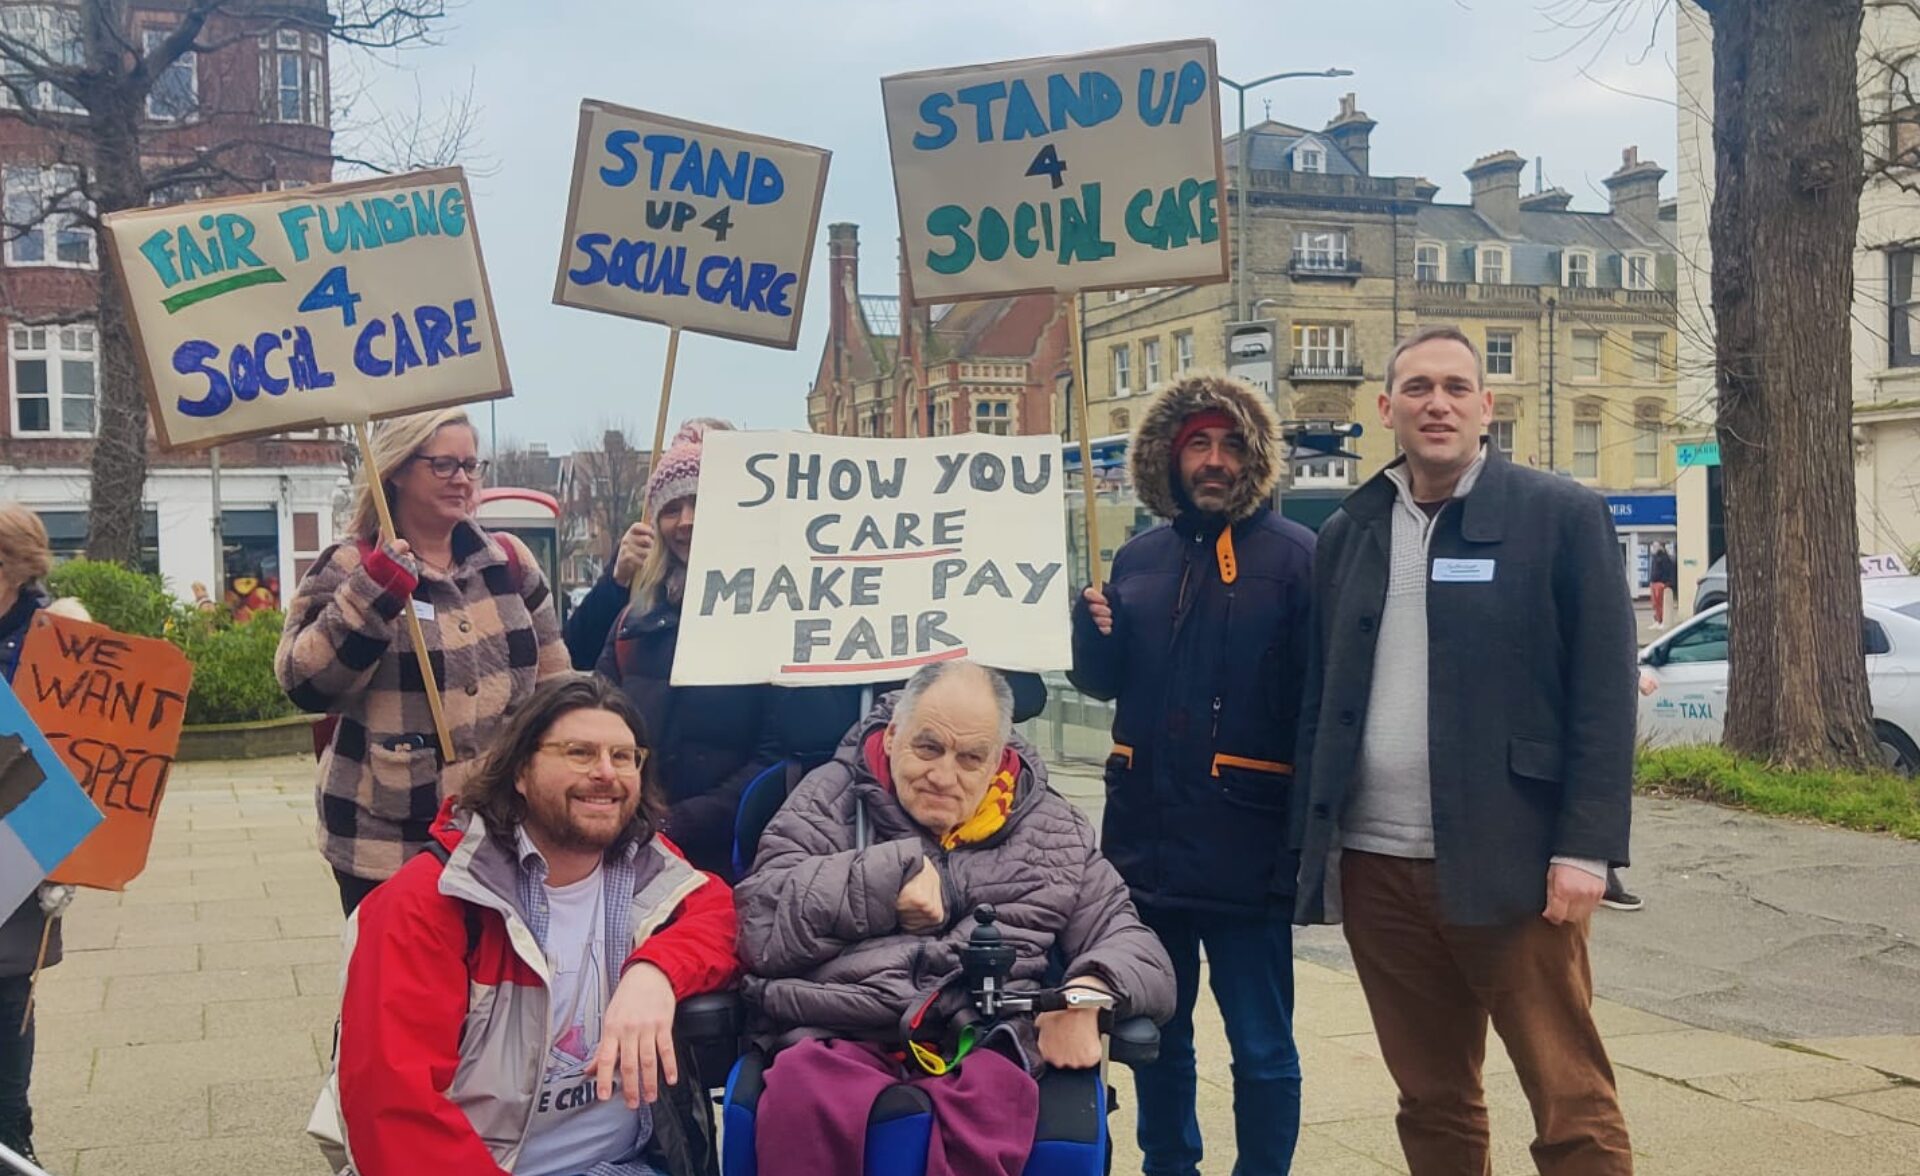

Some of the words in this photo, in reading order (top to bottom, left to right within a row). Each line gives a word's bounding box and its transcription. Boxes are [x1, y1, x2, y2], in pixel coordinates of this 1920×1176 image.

[912, 71, 1123, 151] STAND
[1137, 60, 1207, 127] UP
[599, 129, 785, 205] STAND
[1024, 143, 1068, 190] 4
[646, 200, 697, 232] UP
[925, 181, 1117, 275] SOCIAL
[1124, 177, 1219, 251] CARE
[298, 265, 363, 327] 4
[568, 233, 690, 296] SOCIAL
[696, 255, 797, 317] CARE
[352, 298, 482, 378] CARE
[737, 452, 907, 508] SHOW
[933, 452, 1052, 495] YOU
[805, 509, 967, 555] CARE
[699, 564, 883, 616] MAKE
[931, 558, 1062, 605] PAY
[54, 624, 133, 671] WE
[793, 610, 964, 663] FAIR
[31, 663, 185, 731] WANT
[1678, 702, 1713, 718] TAXI
